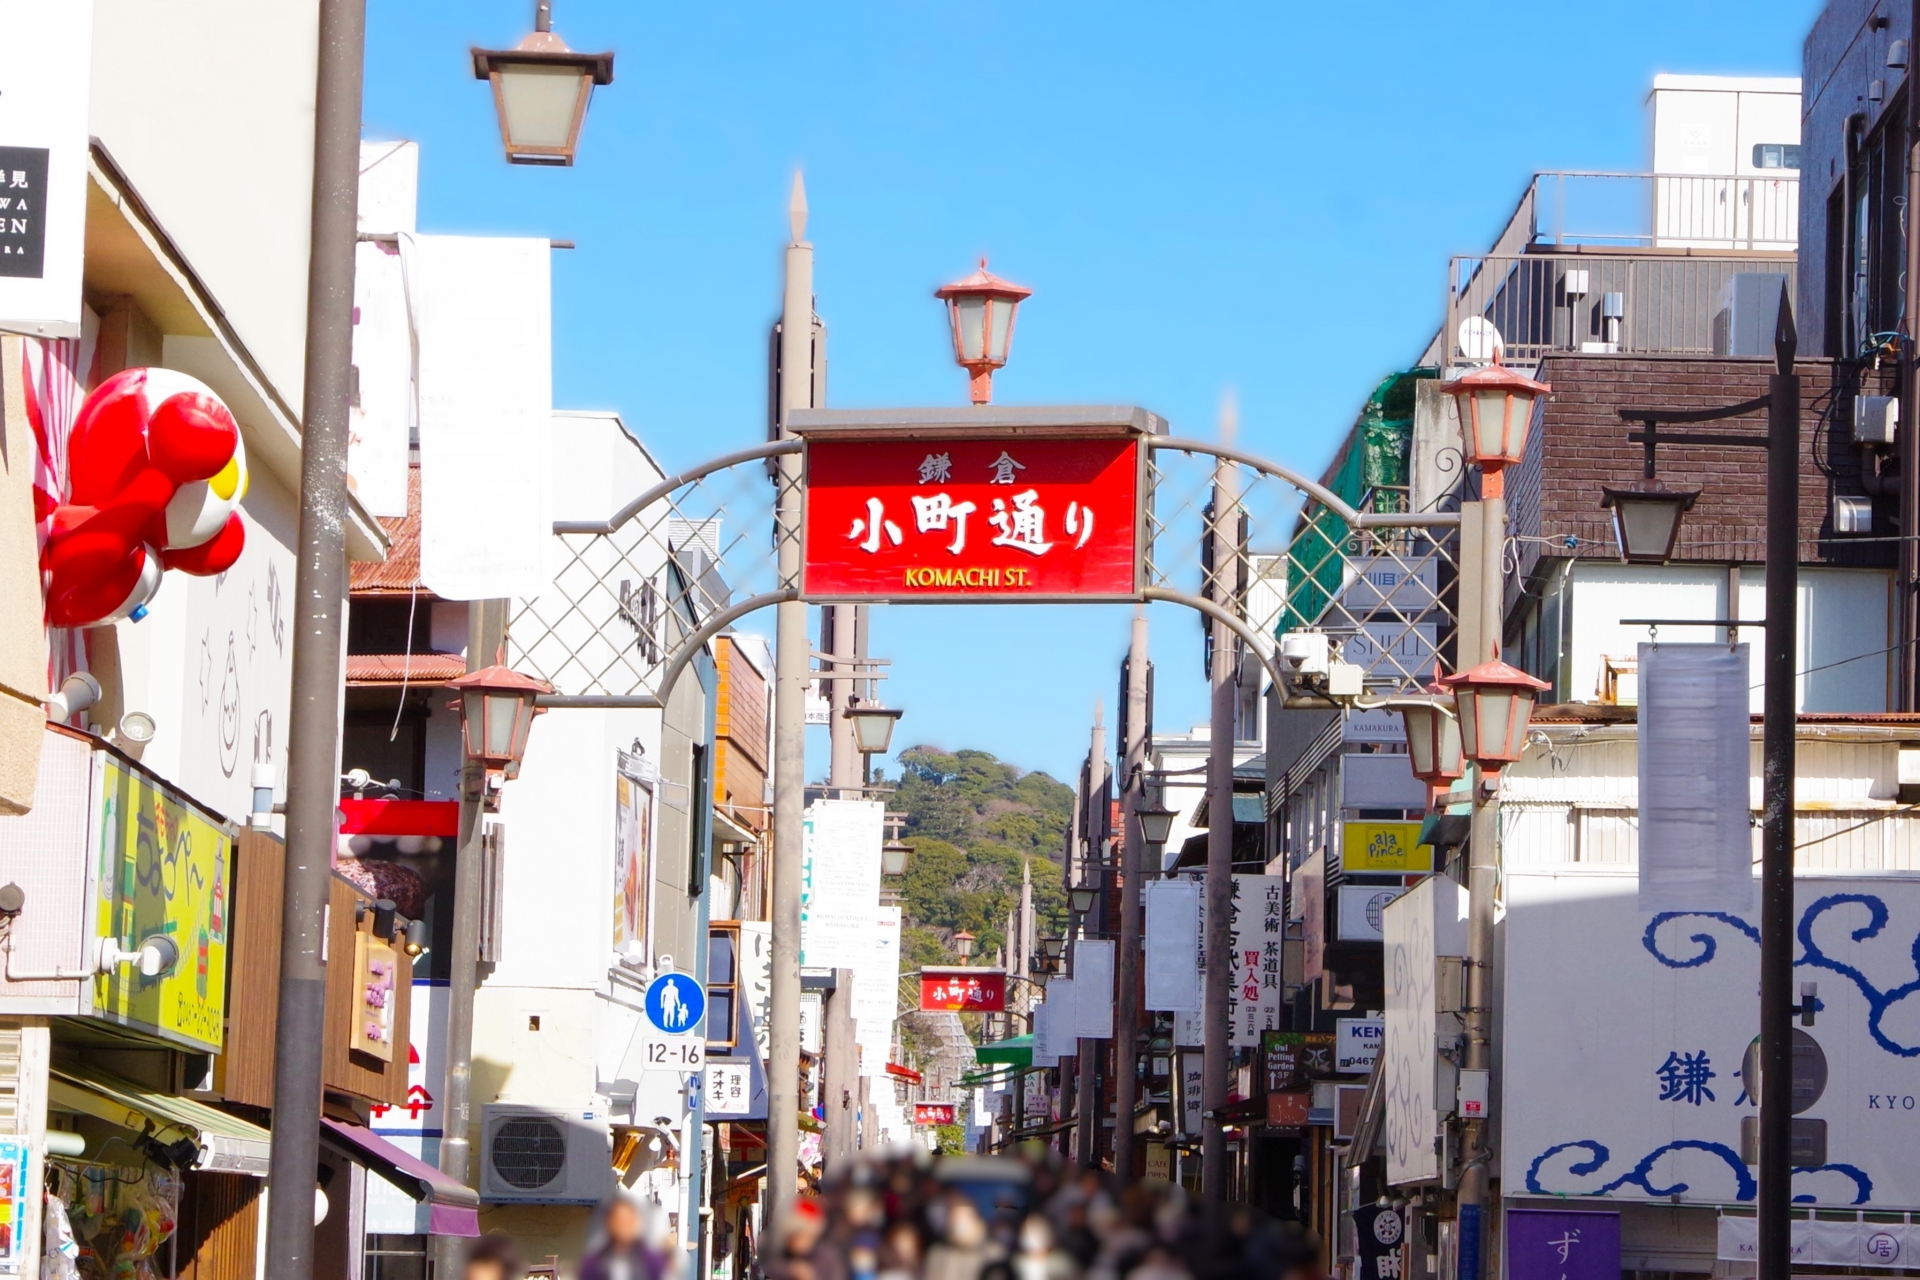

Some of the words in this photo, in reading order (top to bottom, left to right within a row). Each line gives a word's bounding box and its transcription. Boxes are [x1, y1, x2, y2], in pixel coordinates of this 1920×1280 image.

[917, 450, 1026, 485] 鎌倉
[847, 488, 1095, 557] 小町通り
[904, 567, 1000, 588] KOMACHI
[1004, 567, 1032, 588] ST.
[1353, 634, 1429, 657] SHELL
[804, 711, 831, 722] 本商会
[1353, 724, 1400, 733] KAMAKURA
[1264, 885, 1280, 933] 古美術
[1262, 941, 1279, 990] 茶道具
[1242, 950, 1260, 1002] 買入処
[932, 986, 995, 1003] 小町通り
[648, 1043, 700, 1064] 12-16
[1274, 1043, 1288, 1052] Owl
[1267, 1053, 1295, 1063] Petting
[1267, 1062, 1295, 1071] Garden
[712, 1069, 725, 1101] オオキ
[730, 1074, 742, 1098] 理容
[1868, 1094, 1916, 1110] KYO
[1148, 1160, 1169, 1168] CAFE
[1147, 1171, 1169, 1179] OPEN
[1739, 1243, 1803, 1255] KARA
